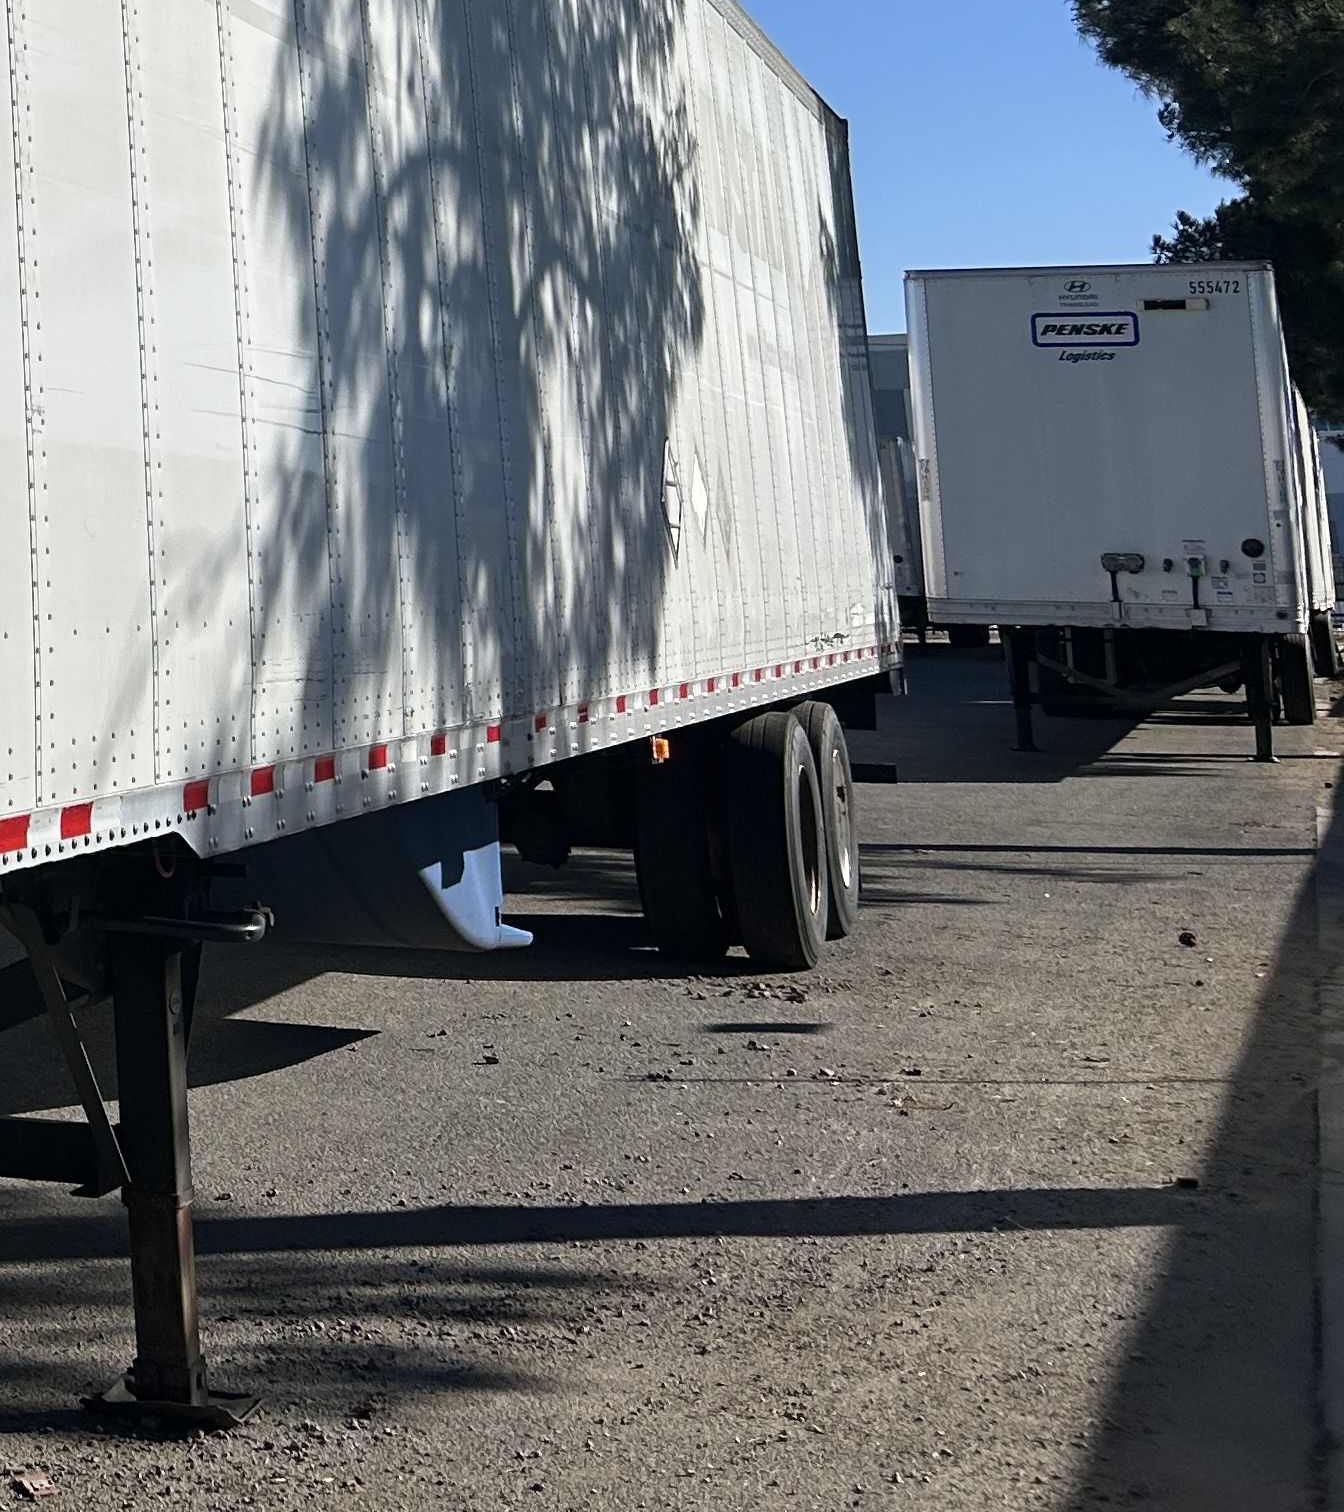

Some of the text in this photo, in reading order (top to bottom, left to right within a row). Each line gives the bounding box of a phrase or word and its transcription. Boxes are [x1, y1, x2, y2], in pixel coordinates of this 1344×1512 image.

[1189, 280, 1240, 295] 555472
[1040, 322, 1131, 336] PENSKE
[1058, 350, 1116, 363] Logistics
